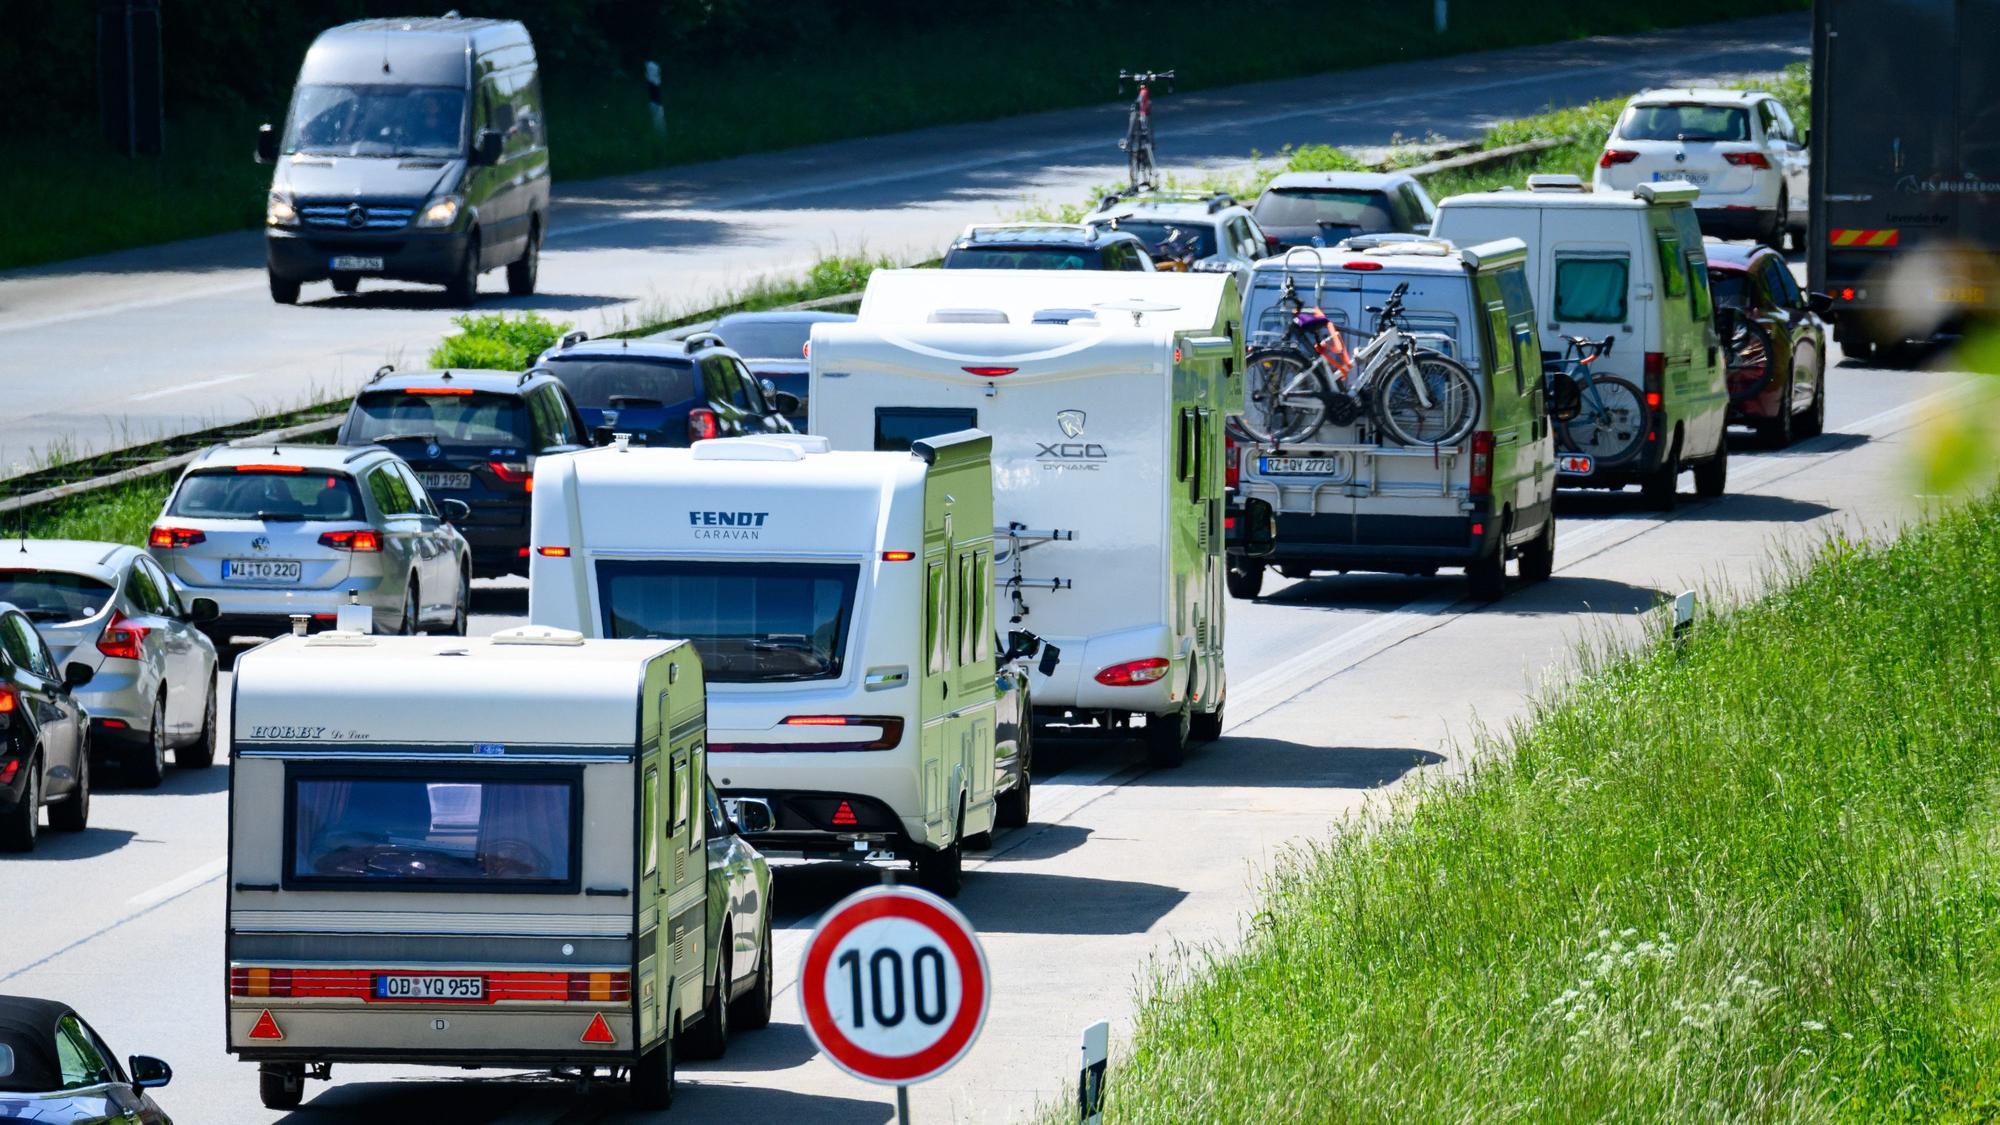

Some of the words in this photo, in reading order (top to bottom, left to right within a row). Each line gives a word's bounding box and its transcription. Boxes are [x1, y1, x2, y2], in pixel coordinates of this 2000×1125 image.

[1035, 442, 1108, 458] XGO
[1043, 463, 1100, 471] DYNAMIC
[1267, 459, 1281, 471] RZ
[689, 511, 769, 526] FENDT
[694, 529, 759, 540] CARAVAN
[274, 563, 298, 577] 220
[250, 726, 326, 739] HOBBY
[388, 978, 411, 995] OD
[423, 978, 445, 995] YQ
[448, 978, 480, 996] 955
[838, 946, 947, 1028] 100
[435, 1019, 445, 1030] D
